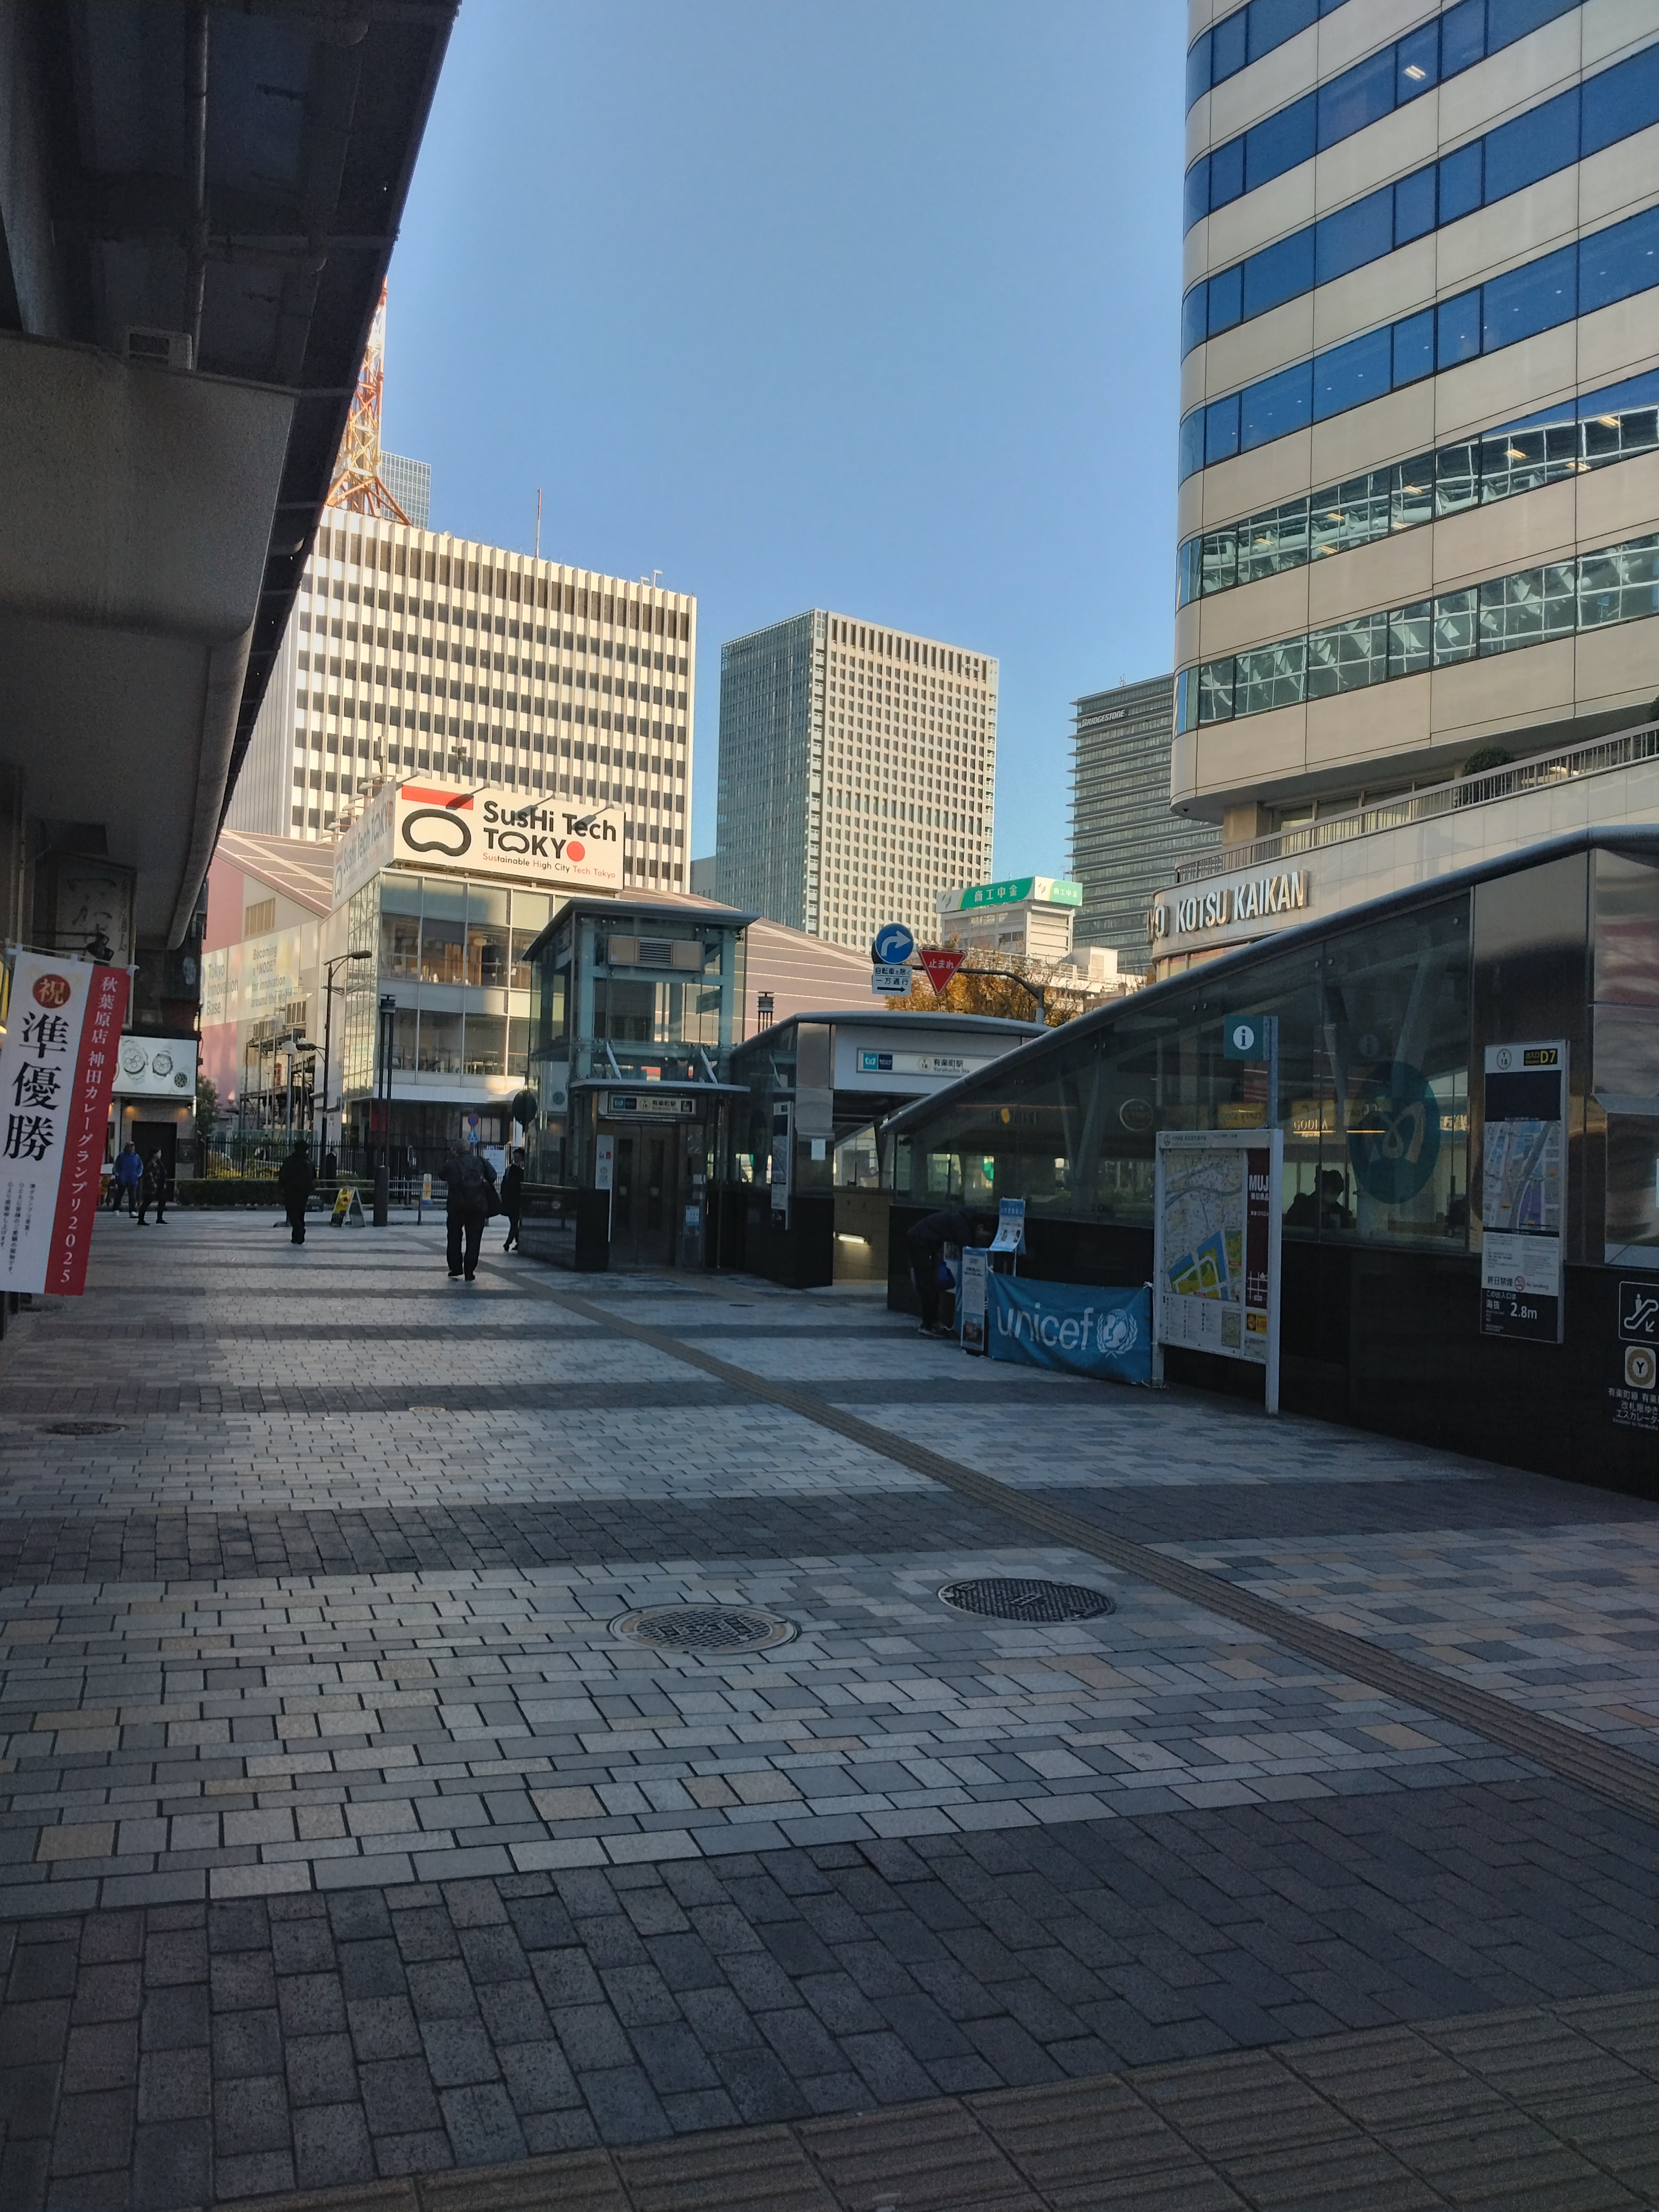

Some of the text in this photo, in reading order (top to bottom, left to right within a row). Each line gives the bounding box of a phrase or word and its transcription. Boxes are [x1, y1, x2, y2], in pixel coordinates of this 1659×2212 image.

[483, 801, 616, 841] SusHi Tech
[483, 852, 616, 878] Sustainable High City Tech Tokyo
[974, 884, 1018, 902] 商工中金
[1053, 887, 1077, 898] 商工中金
[1176, 889, 1230, 933] KOTSU
[1234, 870, 1307, 920] KAIKAN
[253, 944, 278, 960] Becoming
[208, 963, 224, 979] Tokyo
[928, 958, 954, 969] 止まれ
[207, 977, 238, 998] Innovation
[259, 974, 286, 990] innovation
[38, 978, 65, 1006] 祝
[206, 1001, 221, 1016] Base
[934, 1059, 963, 1067] 有楽町駅
[1540, 1050, 1556, 1063] D7
[2, 1012, 70, 1162] 準優勝
[60, 976, 118, 1284] 秋葉原店 神田カレーグランプリ2025
[1294, 1119, 1328, 1130] GODIA
[1249, 1175, 1269, 1192] MUJ
[1486, 1290, 1516, 1300] この出入口は
[1510, 1302, 1537, 1320] 2.8m
[997, 1302, 1094, 1351] unicef
[1636, 1361, 1644, 1373] Y
[1616, 1409, 1659, 1424] エスカレータ
